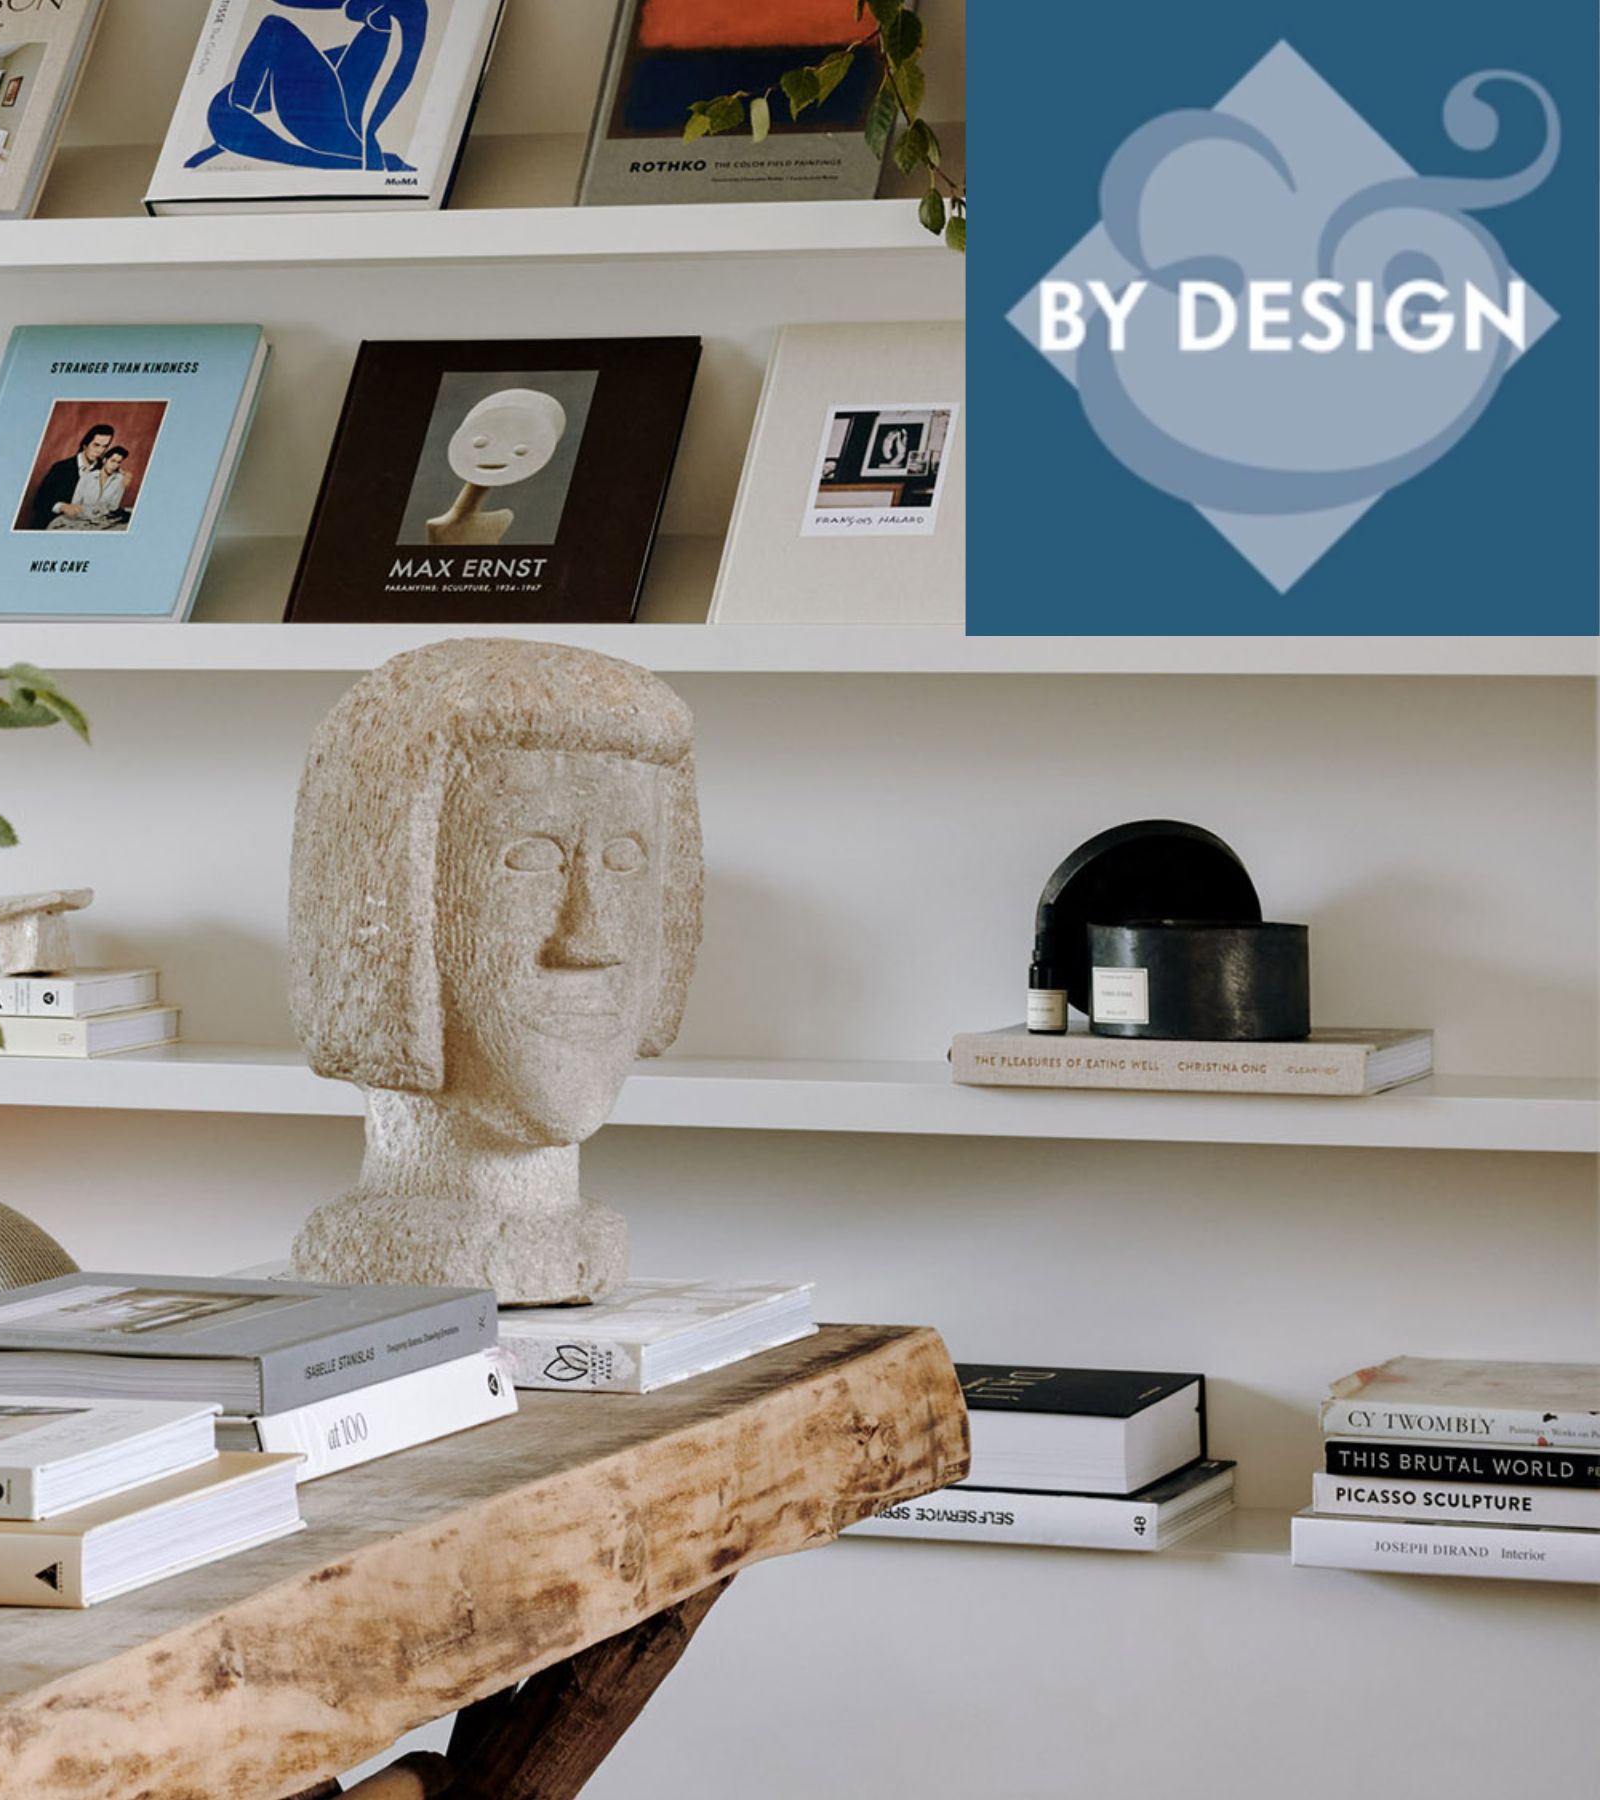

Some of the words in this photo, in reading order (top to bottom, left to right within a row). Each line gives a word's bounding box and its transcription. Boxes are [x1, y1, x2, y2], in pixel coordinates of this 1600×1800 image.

[628, 160, 708, 173] ROTHKO
[714, 161, 732, 169] THE
[733, 160, 766, 169] COLOR
[767, 159, 793, 168] FIELD
[794, 159, 843, 167] PAINTINGS
[384, 177, 419, 186] MoMA
[50, 361, 109, 374] STRANGER
[111, 361, 141, 374] THAN
[142, 361, 200, 374] KINDNESS
[29, 559, 58, 573] NICK
[60, 559, 90, 574] CAVE
[388, 558, 455, 578] MAX
[462, 558, 548, 578] ERNST
[975, 1055, 996, 1066] THE
[1001, 1056, 1061, 1068] PLEASURES
[1066, 1058, 1081, 1068] OF
[1086, 1059, 1126, 1070] EATING
[1131, 1060, 1160, 1071] WELL
[1177, 1061, 1238, 1073] CHRISTINA
[1241, 1063, 1267, 1074] ONG
[305, 1358, 336, 1380] ISABELLE
[338, 1347, 376, 1371] STANISLAS
[327, 1419, 342, 1450] at
[341, 1411, 368, 1446] 100
[1348, 1410, 1377, 1428] CY
[1383, 1413, 1496, 1435] TWOMBLY
[1338, 1450, 1391, 1469] THIS
[1400, 1453, 1485, 1474] BRUTAL
[1492, 1458, 1575, 1478] WORLD
[1336, 1487, 1417, 1506] PICASSO
[1423, 1492, 1533, 1512] SCULPTURE
[1133, 1515, 1146, 1536] 48
[1373, 1541, 1428, 1555] JOSEPH
[1432, 1544, 1489, 1558] DIRAND
[1501, 1548, 1546, 1561] Interior
